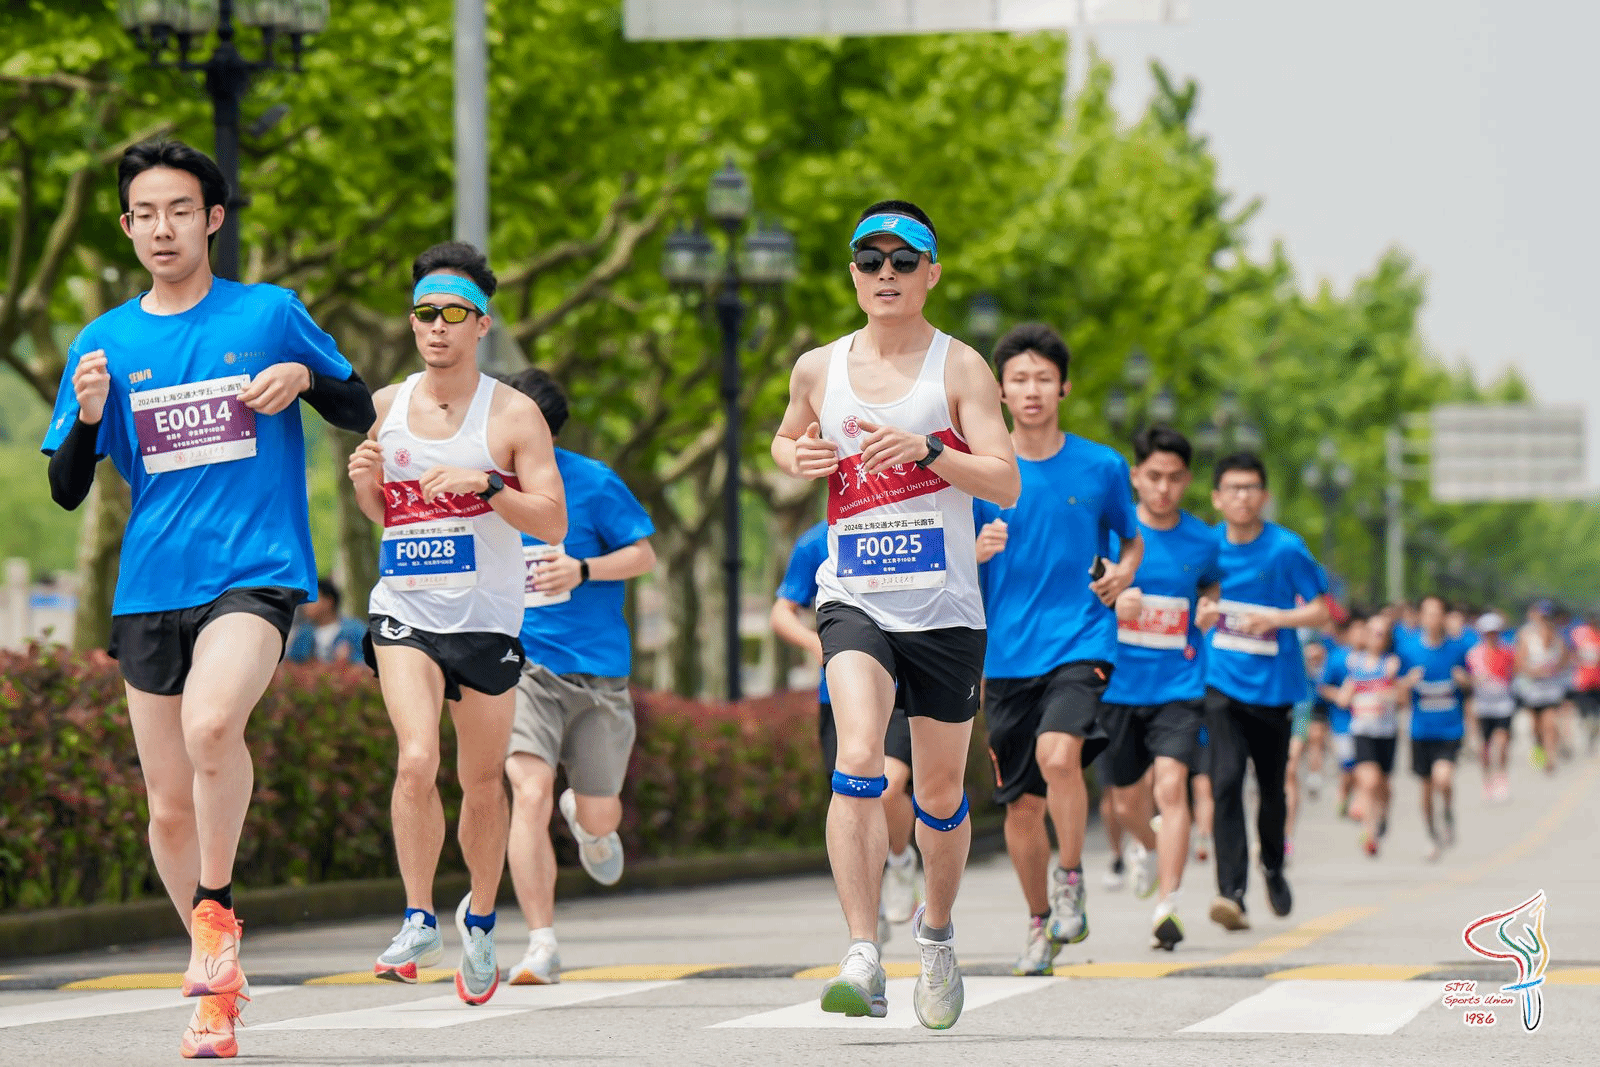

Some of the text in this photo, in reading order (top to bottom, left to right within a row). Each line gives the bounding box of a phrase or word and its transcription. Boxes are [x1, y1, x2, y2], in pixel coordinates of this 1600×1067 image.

[154, 400, 233, 434] E0014
[844, 518, 935, 532] 2024年上海交通大学五一长跑节
[396, 539, 456, 560] F0028
[856, 533, 922, 558] F0025
